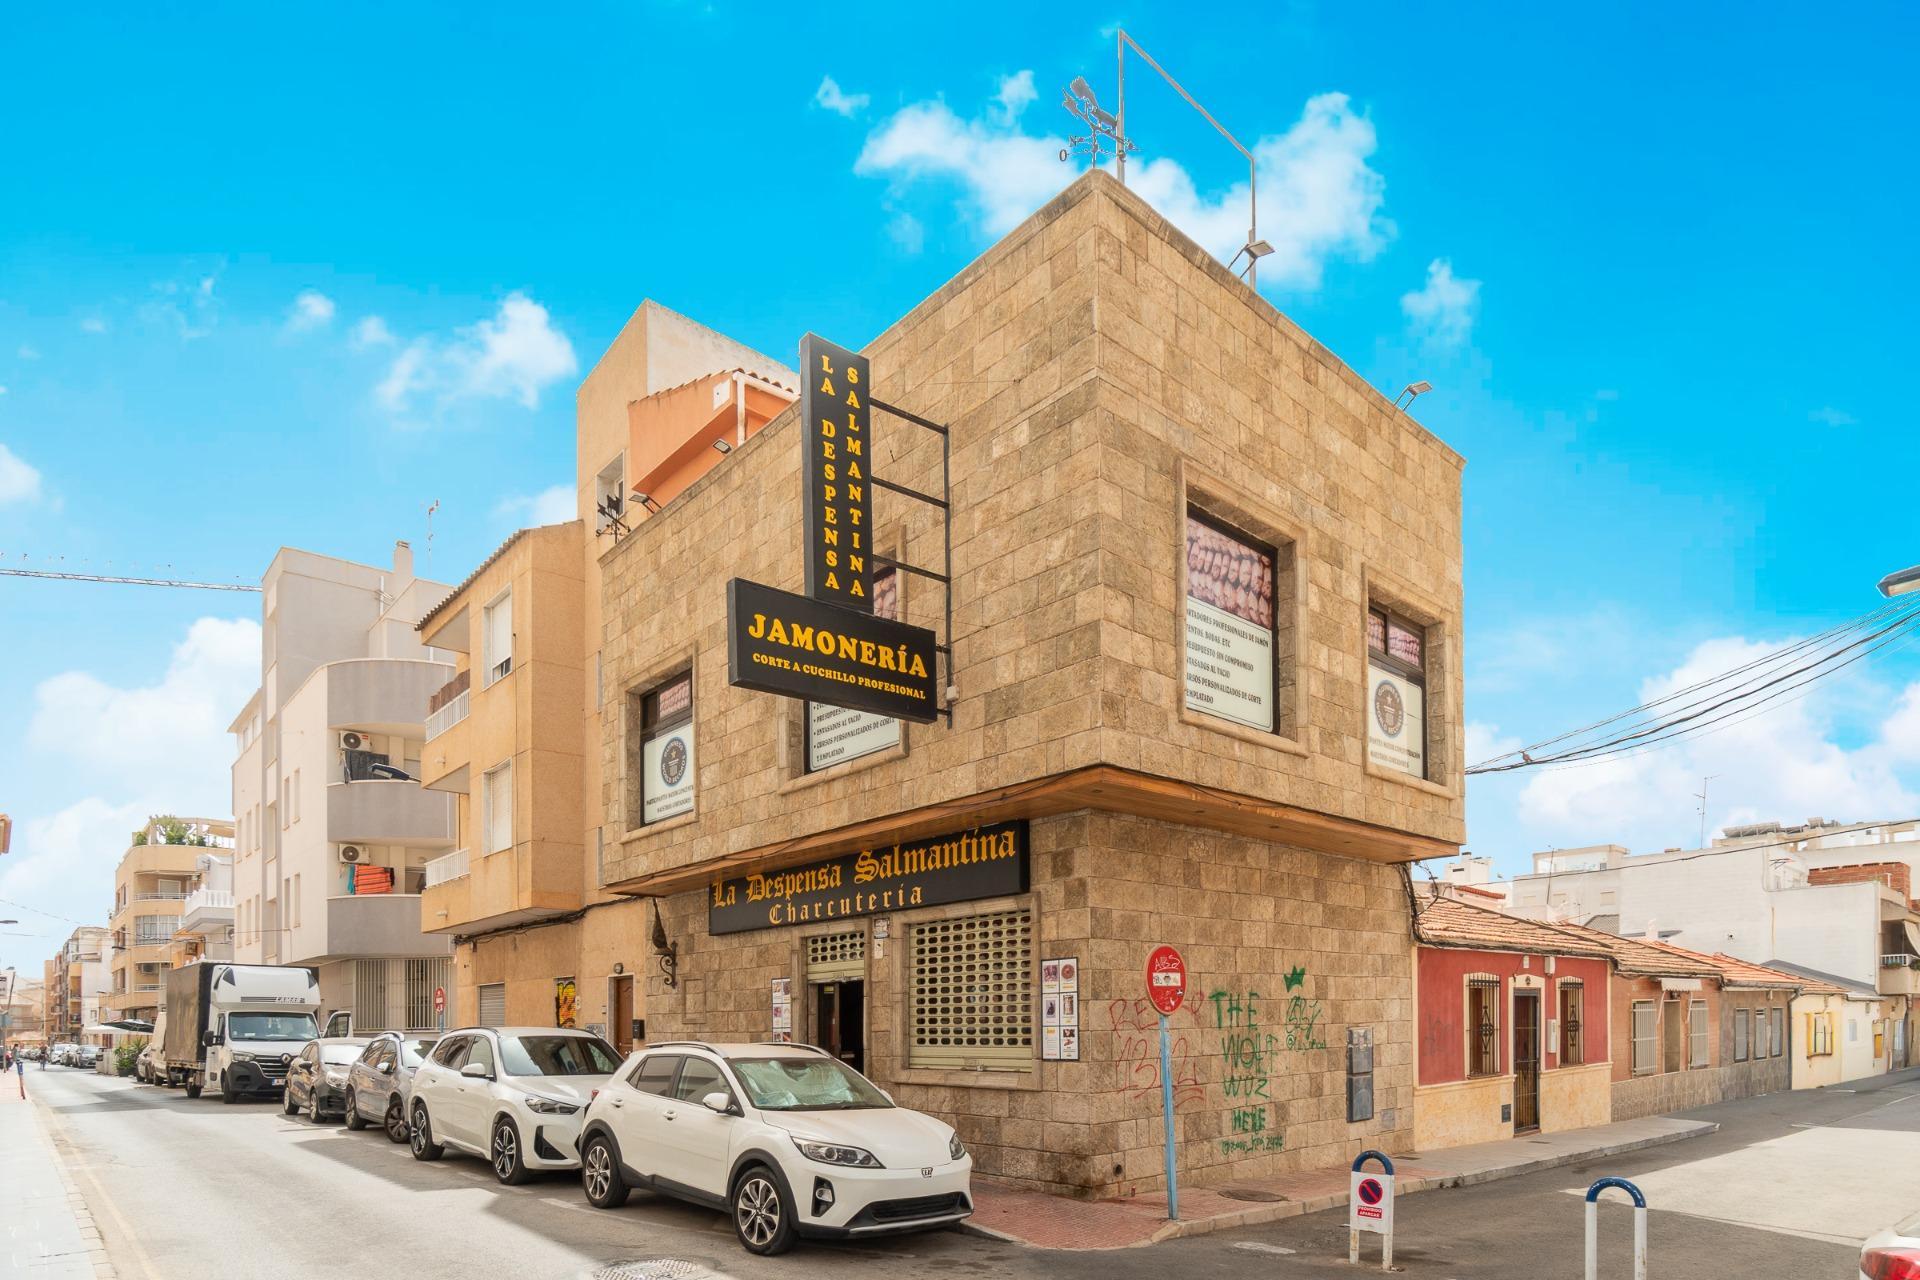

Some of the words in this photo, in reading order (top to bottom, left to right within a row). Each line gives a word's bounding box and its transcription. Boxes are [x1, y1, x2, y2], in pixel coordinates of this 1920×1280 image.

[820, 354, 837, 397] LA
[845, 366, 865, 598] SALMANTINA
[822, 418, 840, 590] DESPENSA
[748, 613, 928, 679] JAMONERÍA
[1213, 618, 1248, 640] PROFESIONALES
[1249, 632, 1255, 642] DE
[753, 652, 791, 670] CORTE
[792, 661, 801, 672] A
[802, 664, 856, 684] CUCHILLO
[858, 676, 926, 700] PROFESIONAL
[1225, 654, 1254, 672] COMPROMISO
[1202, 677, 1241, 698] PERSONALIZADOS
[1242, 690, 1248, 700] DE
[1248, 691, 1262, 705] CORTE
[817, 721, 841, 736] ENVASADOS
[817, 737, 833, 749] CURSOS
[833, 723, 872, 743] PERSONALIZADOS
[873, 721, 879, 730] DE
[711, 877, 736, 908] La
[746, 863, 842, 904] Despensa
[854, 829, 1017, 885] Salmantina
[1209, 991, 1260, 1031] THE
